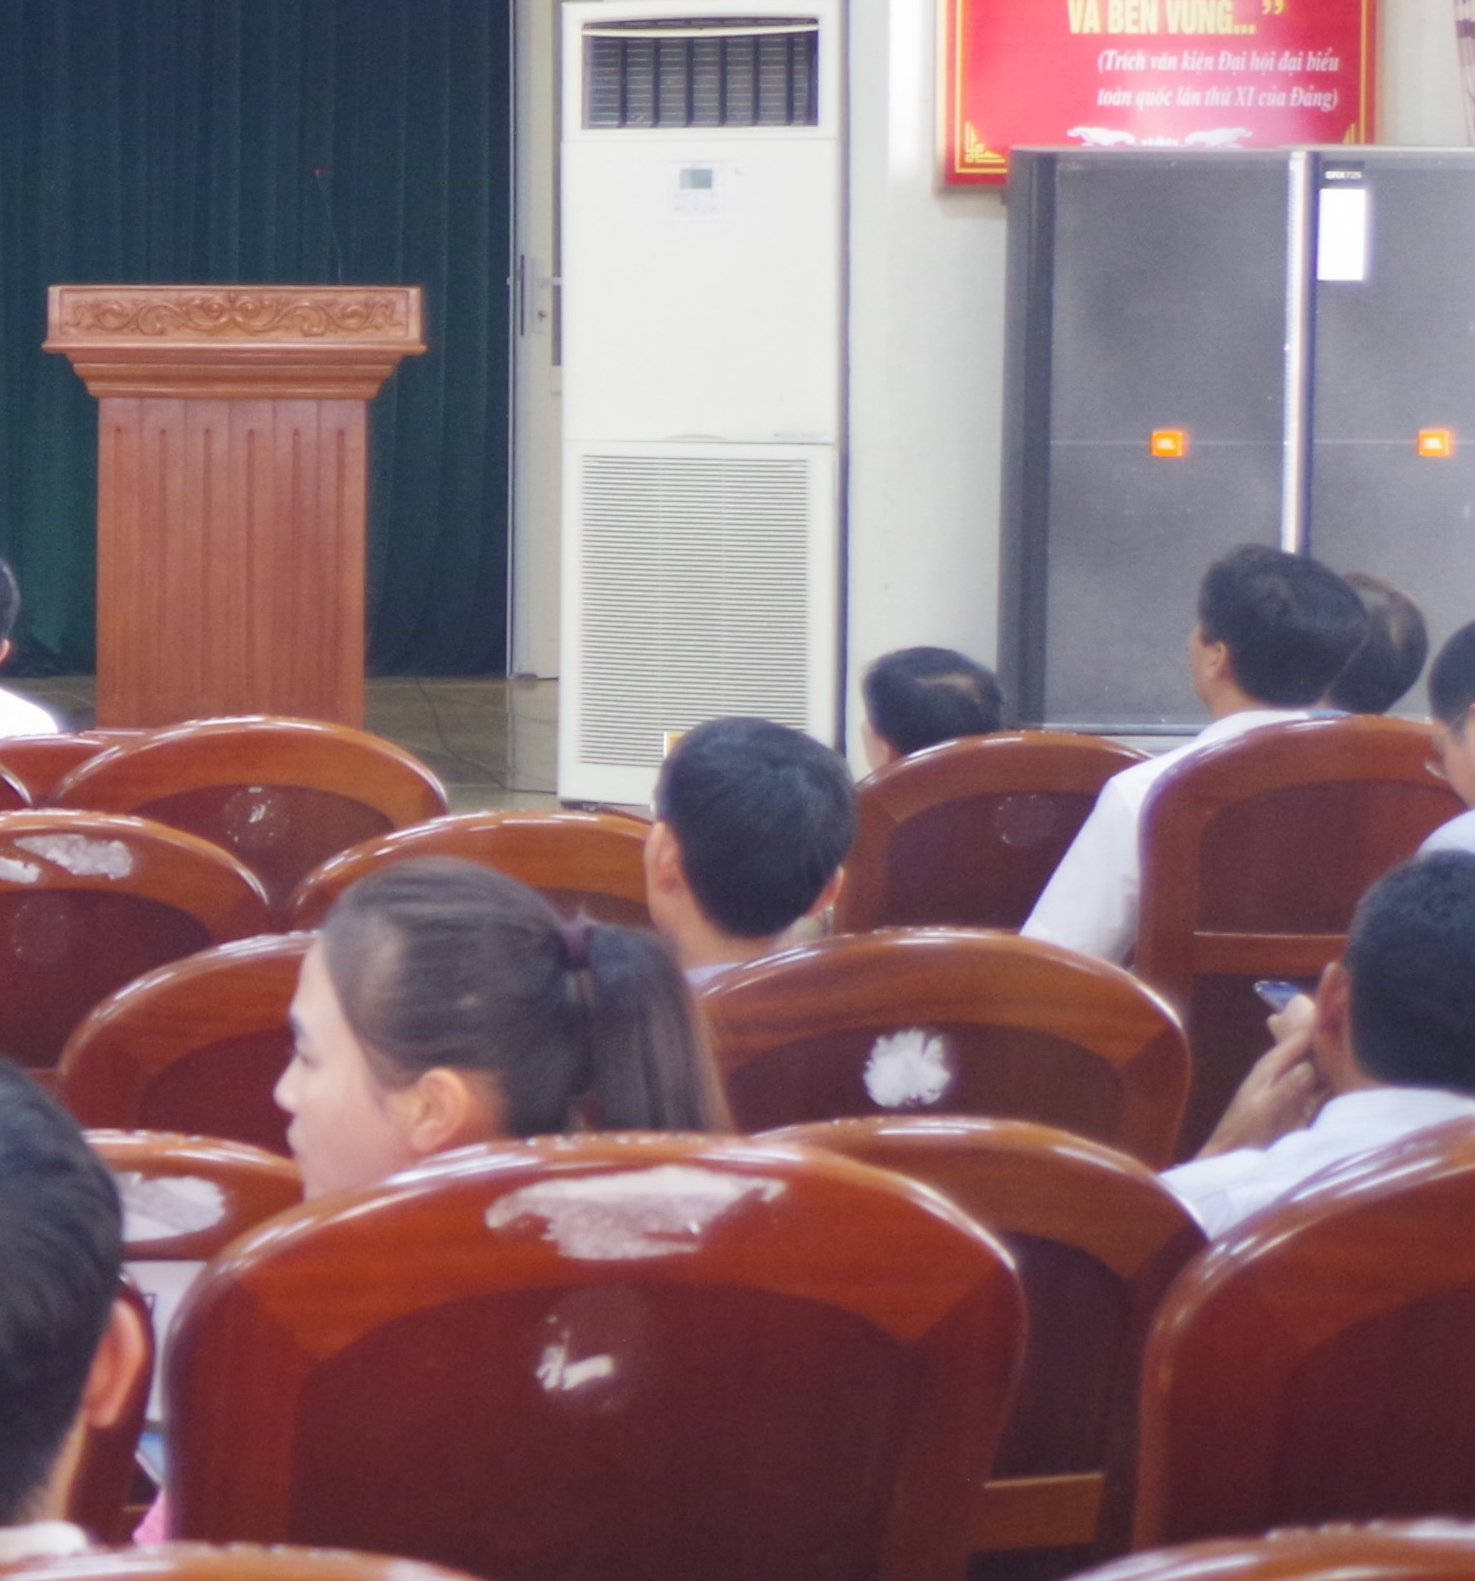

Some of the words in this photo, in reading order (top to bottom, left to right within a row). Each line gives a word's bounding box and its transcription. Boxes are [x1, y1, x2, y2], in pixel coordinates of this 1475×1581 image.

[1097, 49, 1145, 73] (Trích
[1182, 50, 1214, 76] kiện
[1218, 50, 1246, 76] Đại
[1251, 50, 1275, 76] hội
[1278, 50, 1303, 76] đại
[1306, 47, 1340, 72] biểu
[1097, 85, 1131, 106] toàn
[1136, 83, 1171, 110] quốc
[1205, 85, 1232, 107] thứ
[1234, 87, 1256, 107] XI
[1258, 85, 1286, 107] của
[1290, 83, 1339, 112] Đảng)
